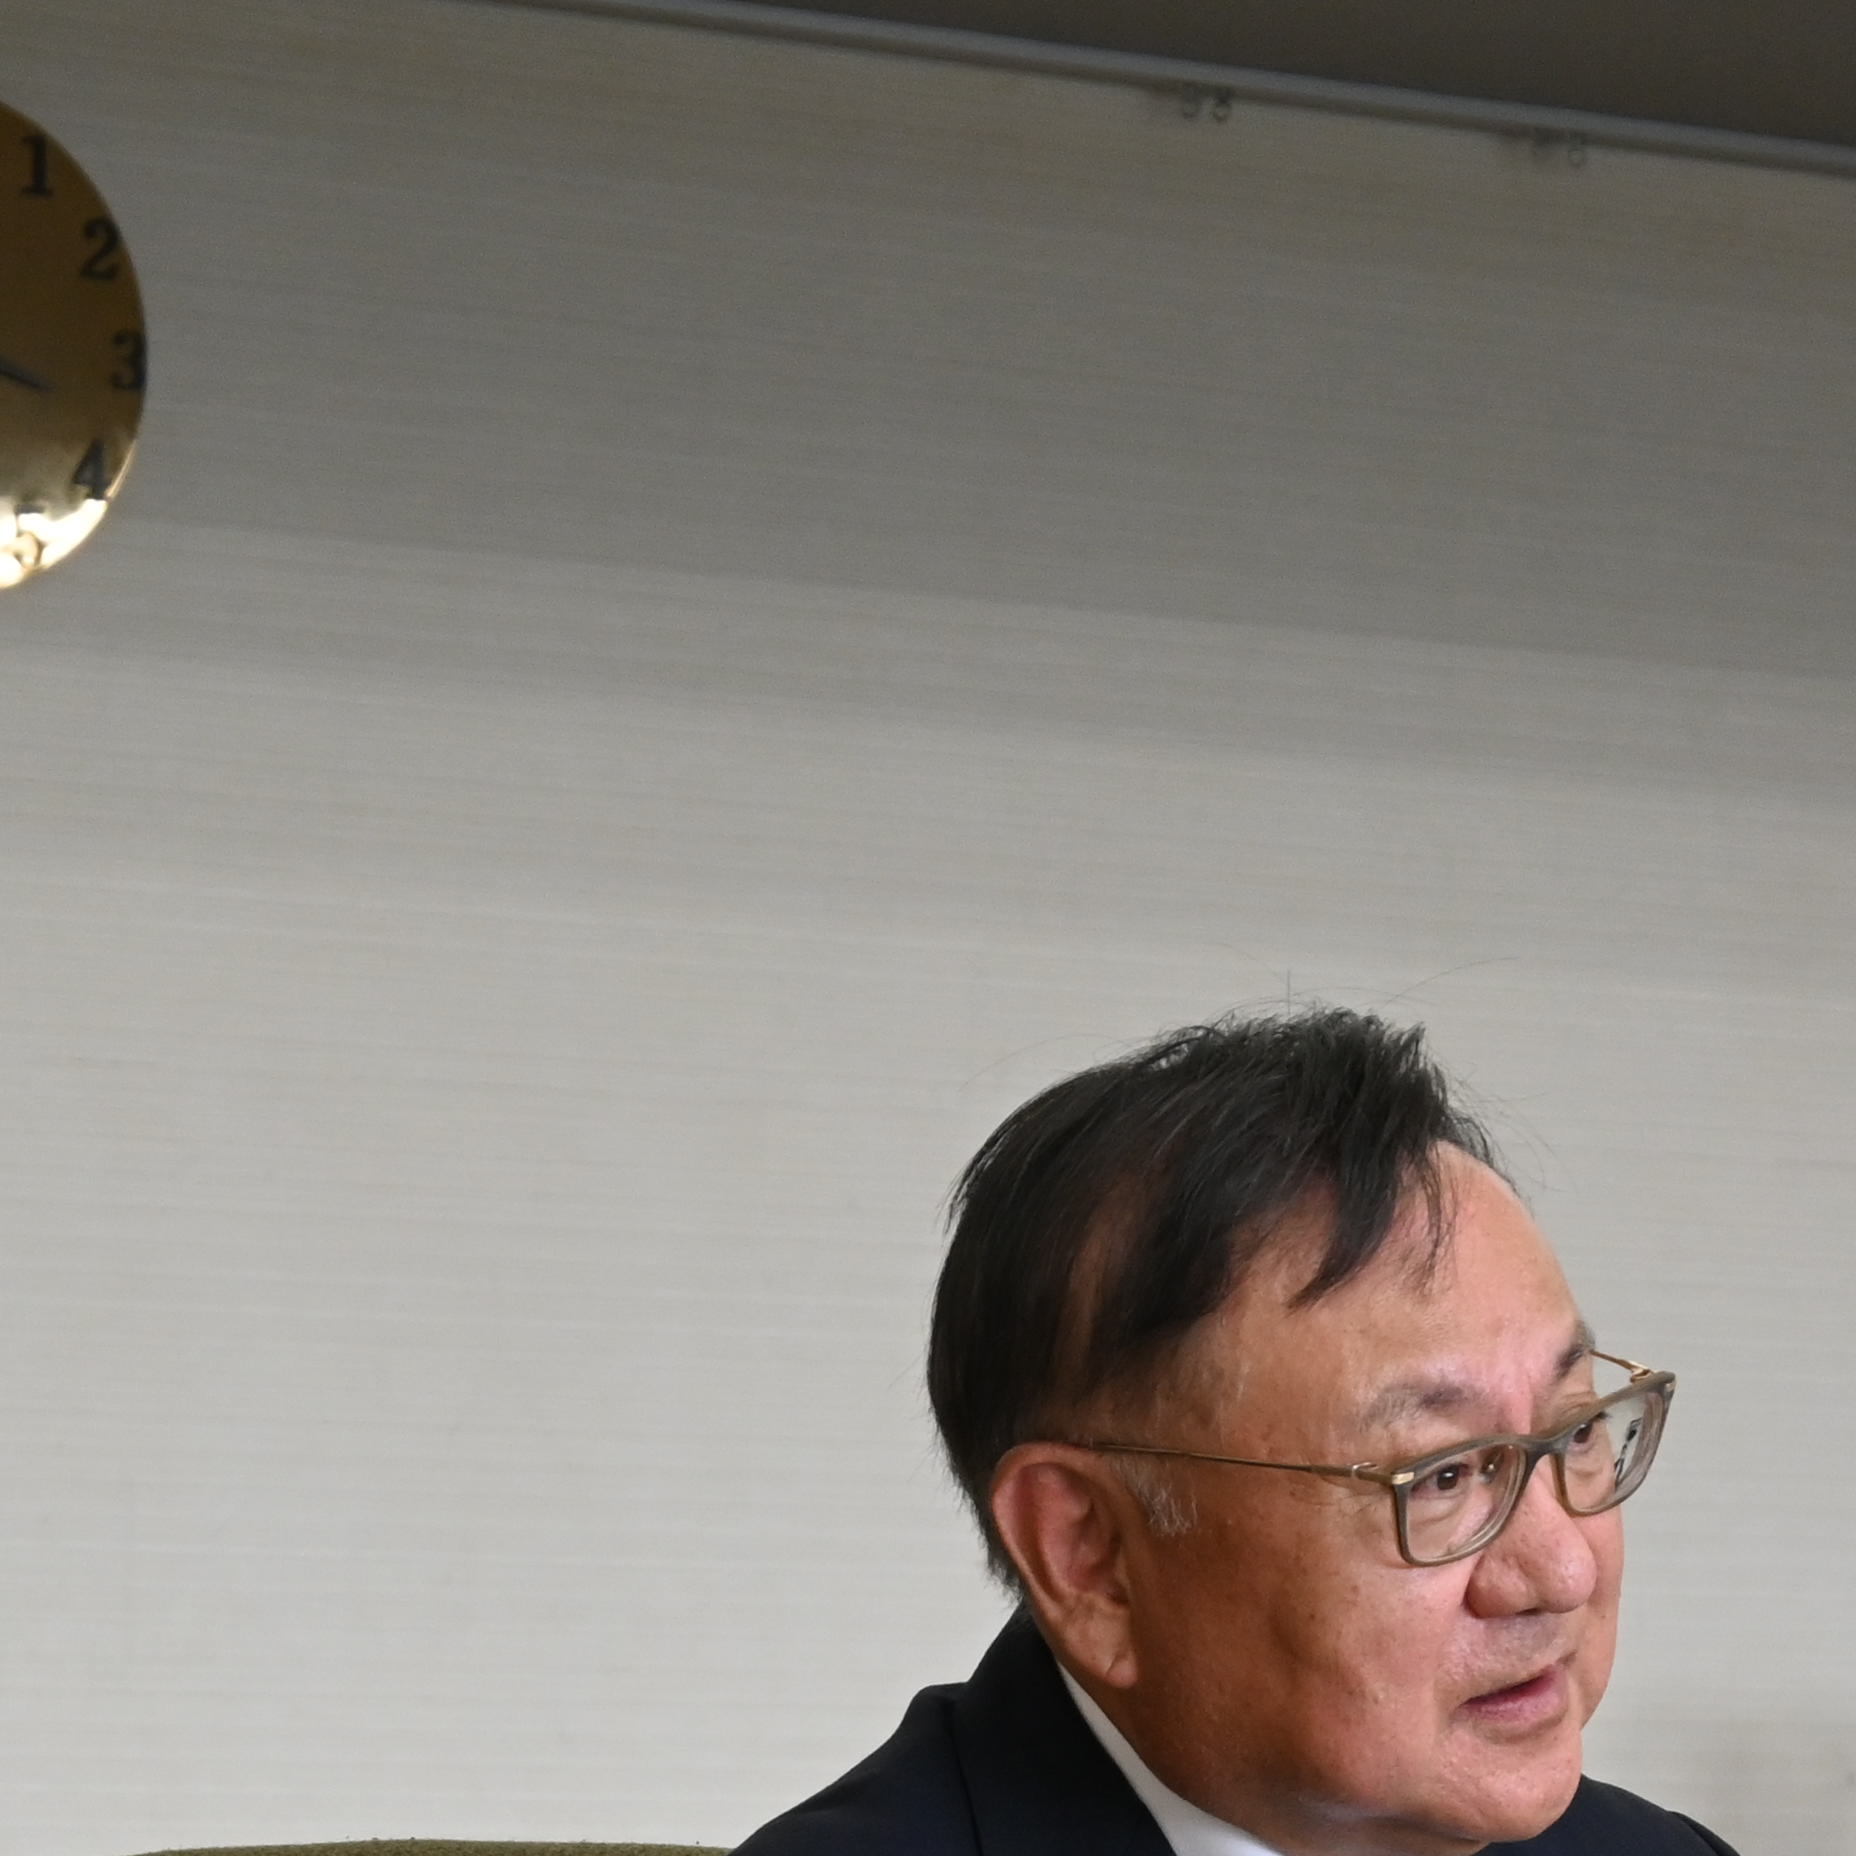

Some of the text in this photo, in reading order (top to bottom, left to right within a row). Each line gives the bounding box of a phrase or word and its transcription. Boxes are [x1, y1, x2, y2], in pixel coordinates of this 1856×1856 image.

[21, 134, 54, 198] 1
[80, 217, 121, 280] 2
[111, 328, 147, 391] 3
[73, 438, 111, 501] 4
